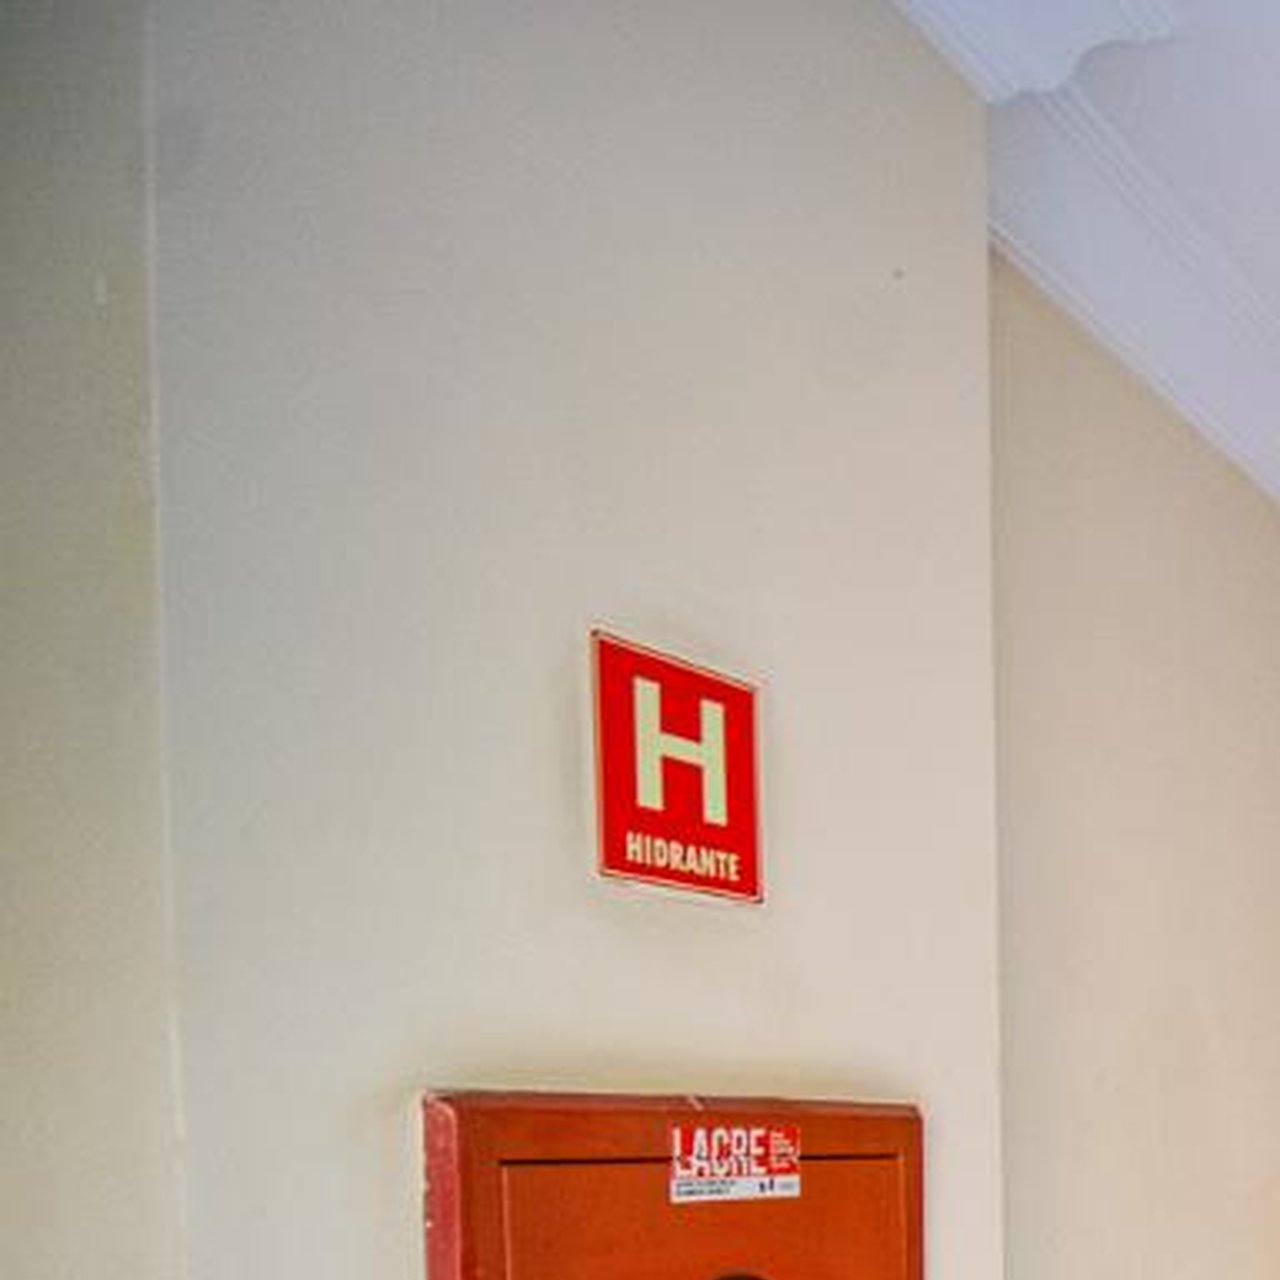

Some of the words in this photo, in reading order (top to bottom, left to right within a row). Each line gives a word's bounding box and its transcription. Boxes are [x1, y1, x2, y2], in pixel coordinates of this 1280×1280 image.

[633, 675, 727, 827] H
[626, 831, 742, 882] HIDRANTE
[673, 1127, 767, 1177] LACRE
